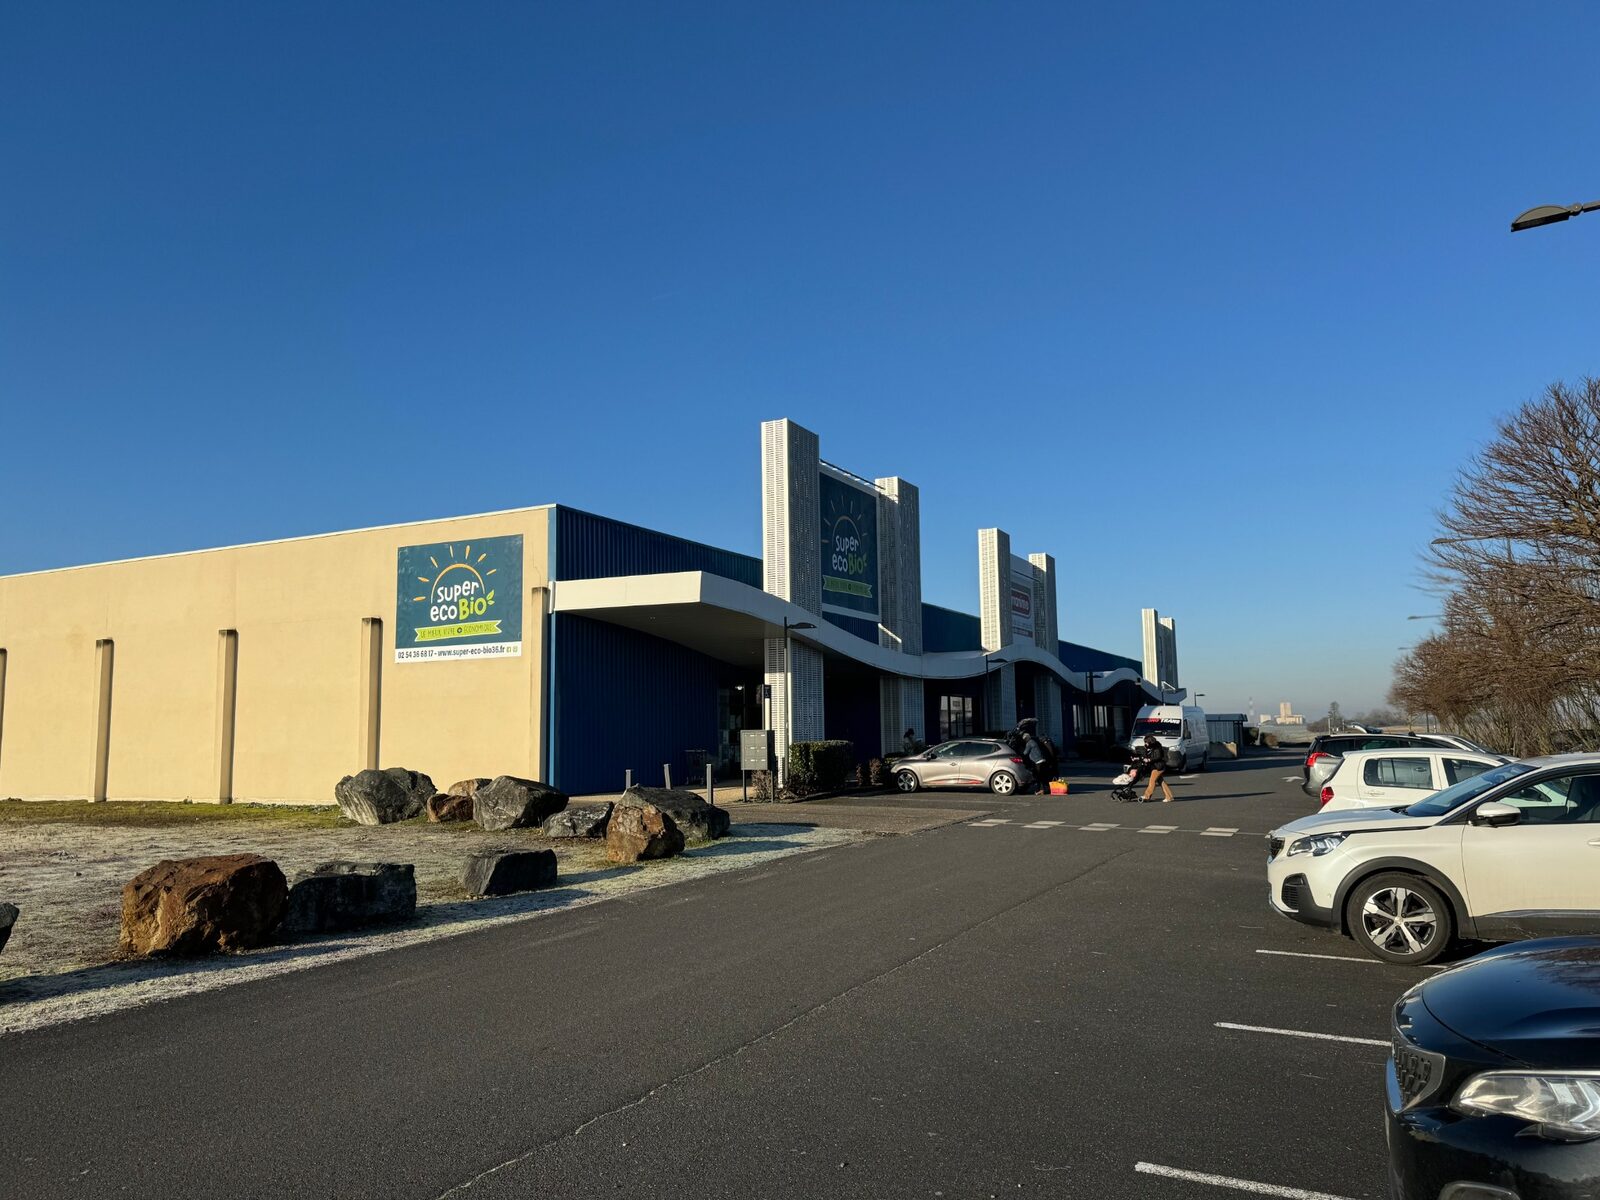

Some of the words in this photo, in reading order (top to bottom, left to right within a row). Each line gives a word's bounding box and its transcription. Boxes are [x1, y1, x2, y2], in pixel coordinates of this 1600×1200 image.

[835, 535, 859, 555] super
[437, 581, 479, 602] super
[398, 651, 404, 659] 02
[405, 651, 412, 659] 54
[428, 649, 434, 657] 17
